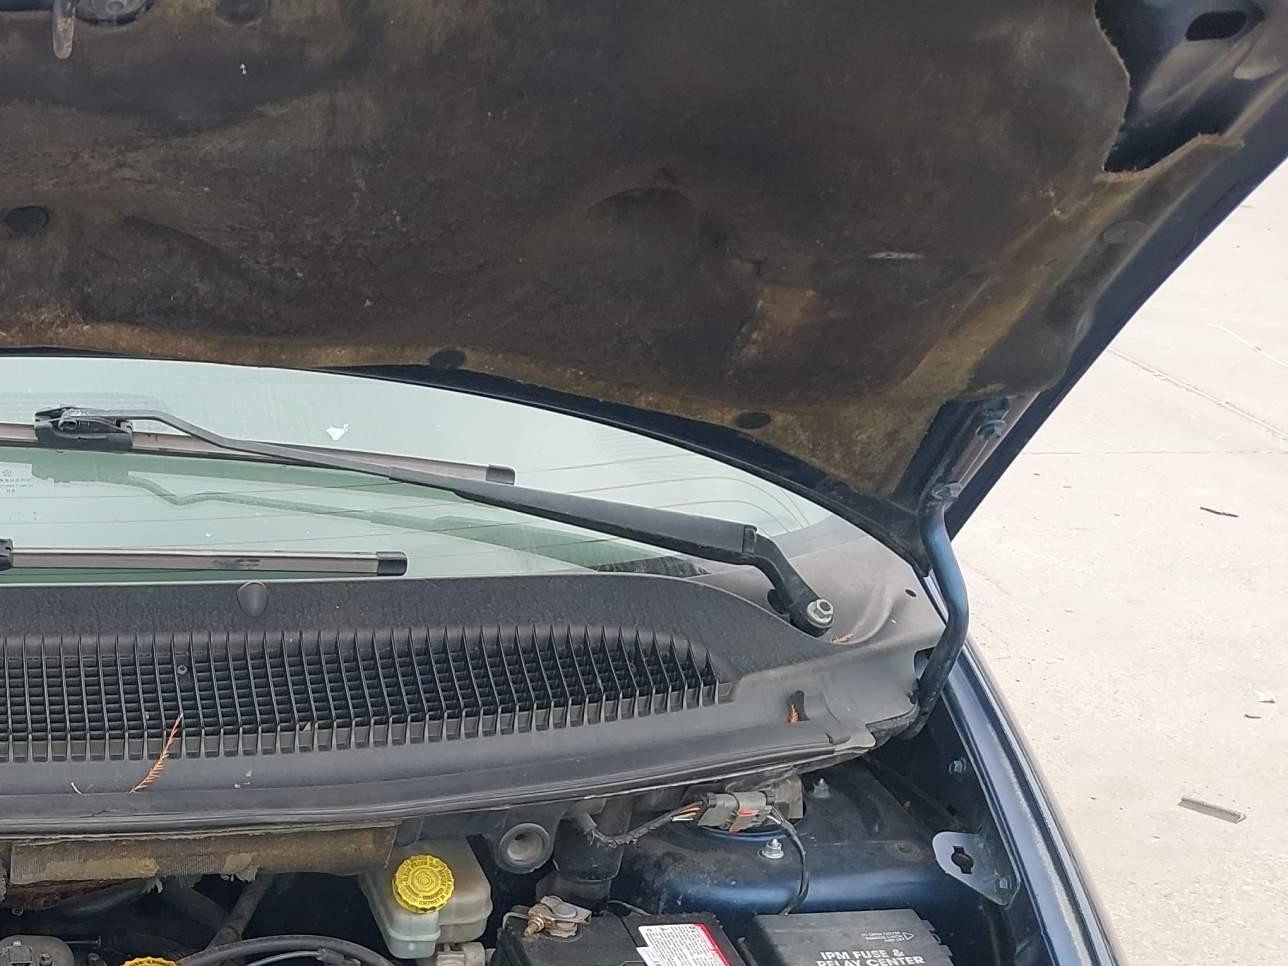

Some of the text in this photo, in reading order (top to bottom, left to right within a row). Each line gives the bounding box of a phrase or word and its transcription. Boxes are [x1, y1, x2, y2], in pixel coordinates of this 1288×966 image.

[819, 948, 905, 960] IPM FUSE &
